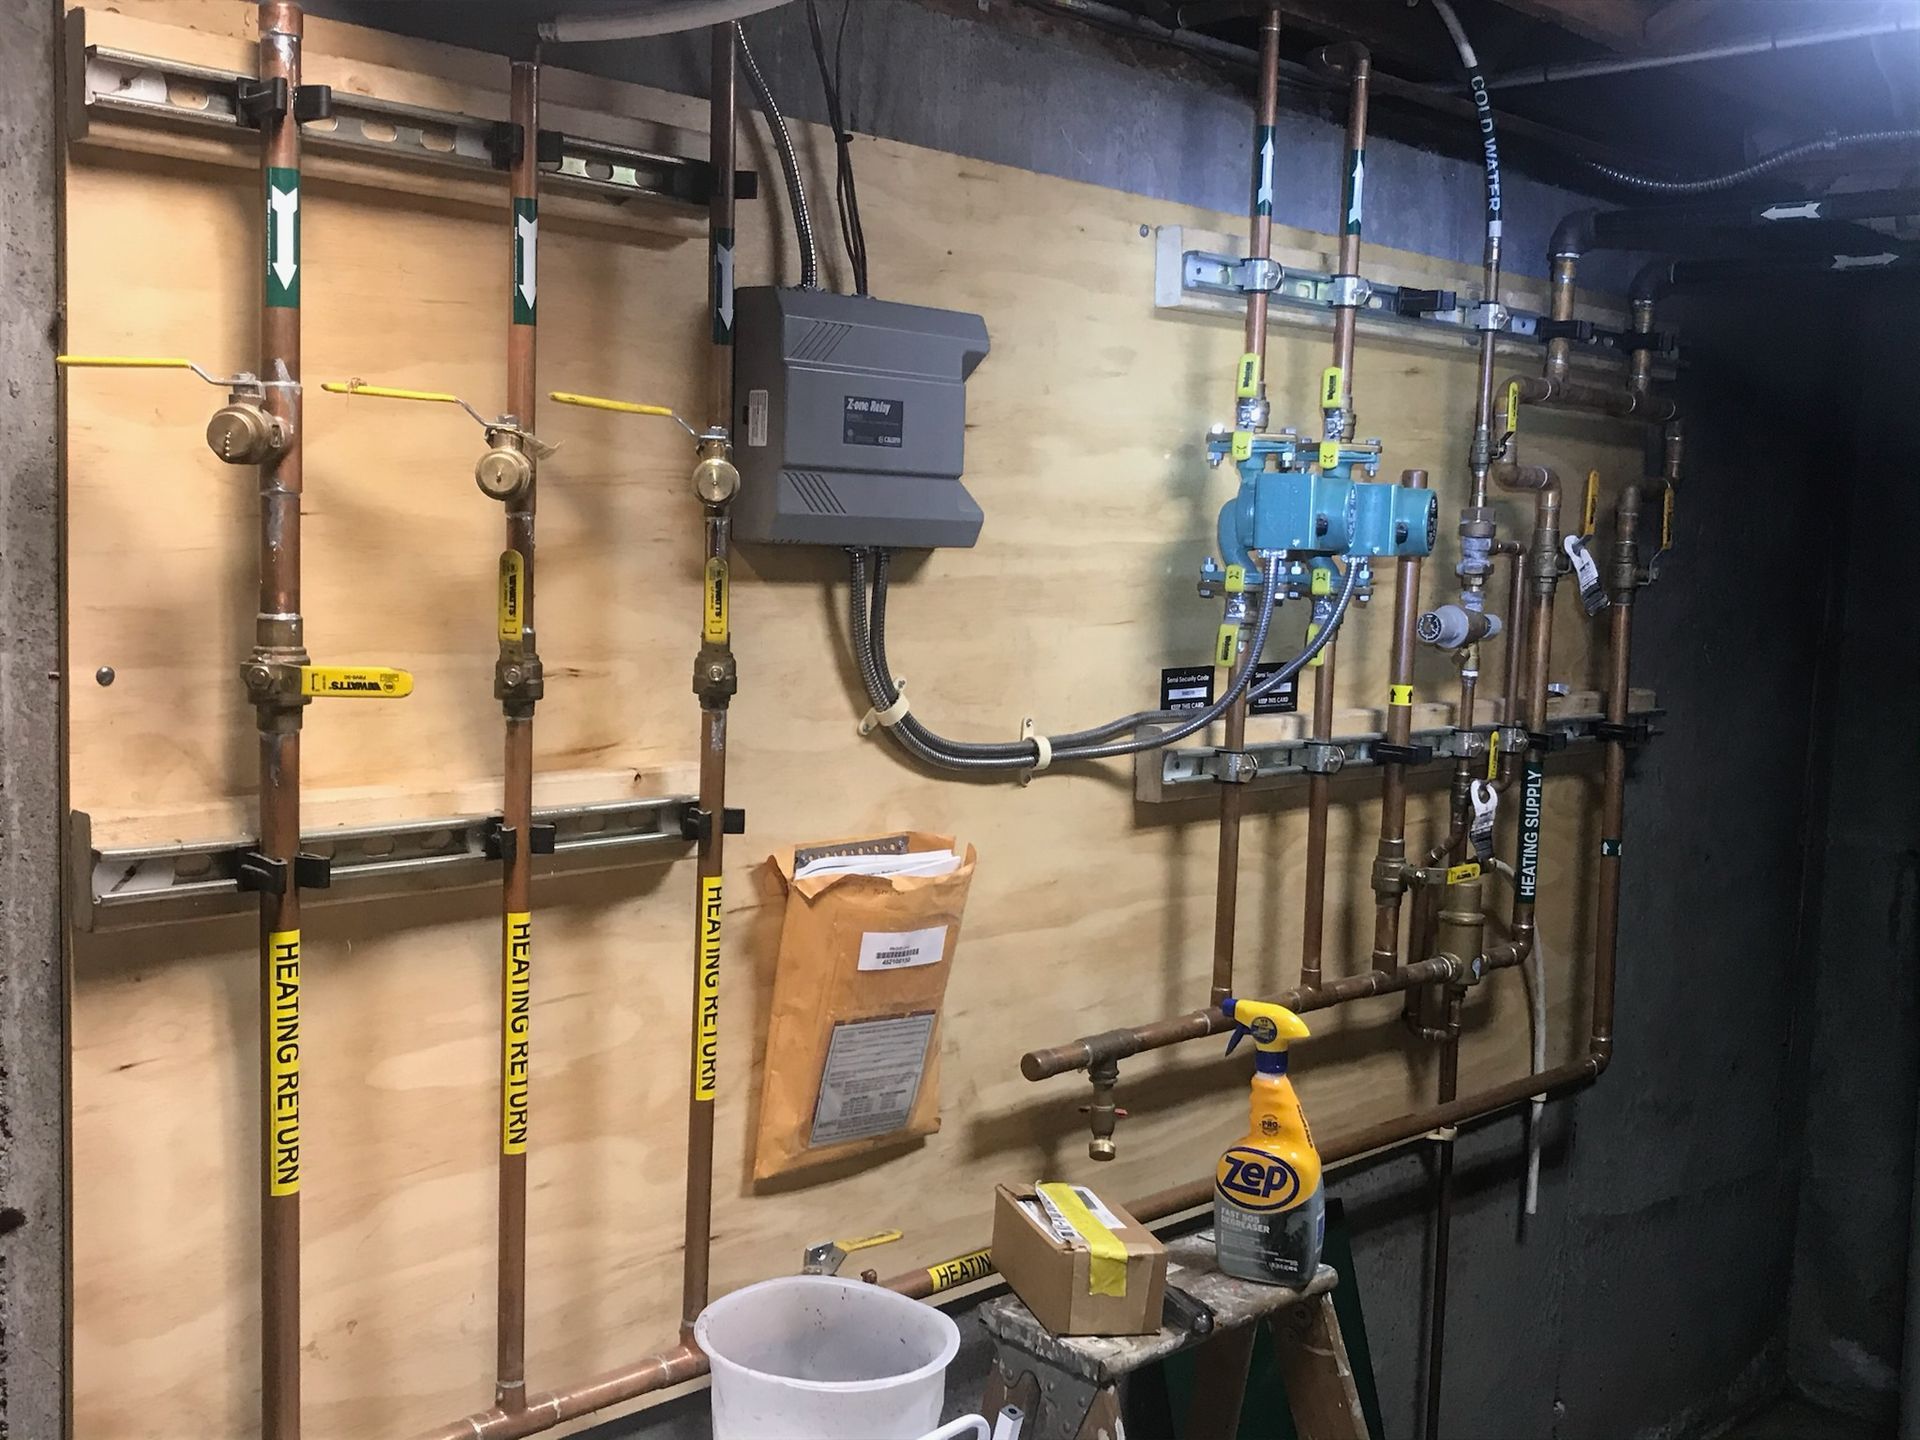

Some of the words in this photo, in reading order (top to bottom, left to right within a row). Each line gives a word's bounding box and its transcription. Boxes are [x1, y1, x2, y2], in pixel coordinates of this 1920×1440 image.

[1470, 75, 1494, 133] COLD
[1483, 137, 1501, 211] WATER
[870, 400, 891, 416] Relay
[329, 681, 382, 691] WATTS
[1192, 701, 1205, 709] CARD
[1524, 770, 1543, 828] SUPPLY
[1520, 832, 1539, 896] HEATING
[705, 886, 722, 988] HEATING
[275, 942, 299, 1064] HEATING
[511, 923, 531, 1034] HEATING
[701, 996, 719, 1091] RETURN
[508, 1041, 529, 1145] RETURN
[276, 1071, 299, 1185] RETURN
[1221, 1207, 1240, 1219] FAST
[1221, 1215, 1271, 1234] DEGREASER
[936, 1252, 993, 1288] HEATIN
